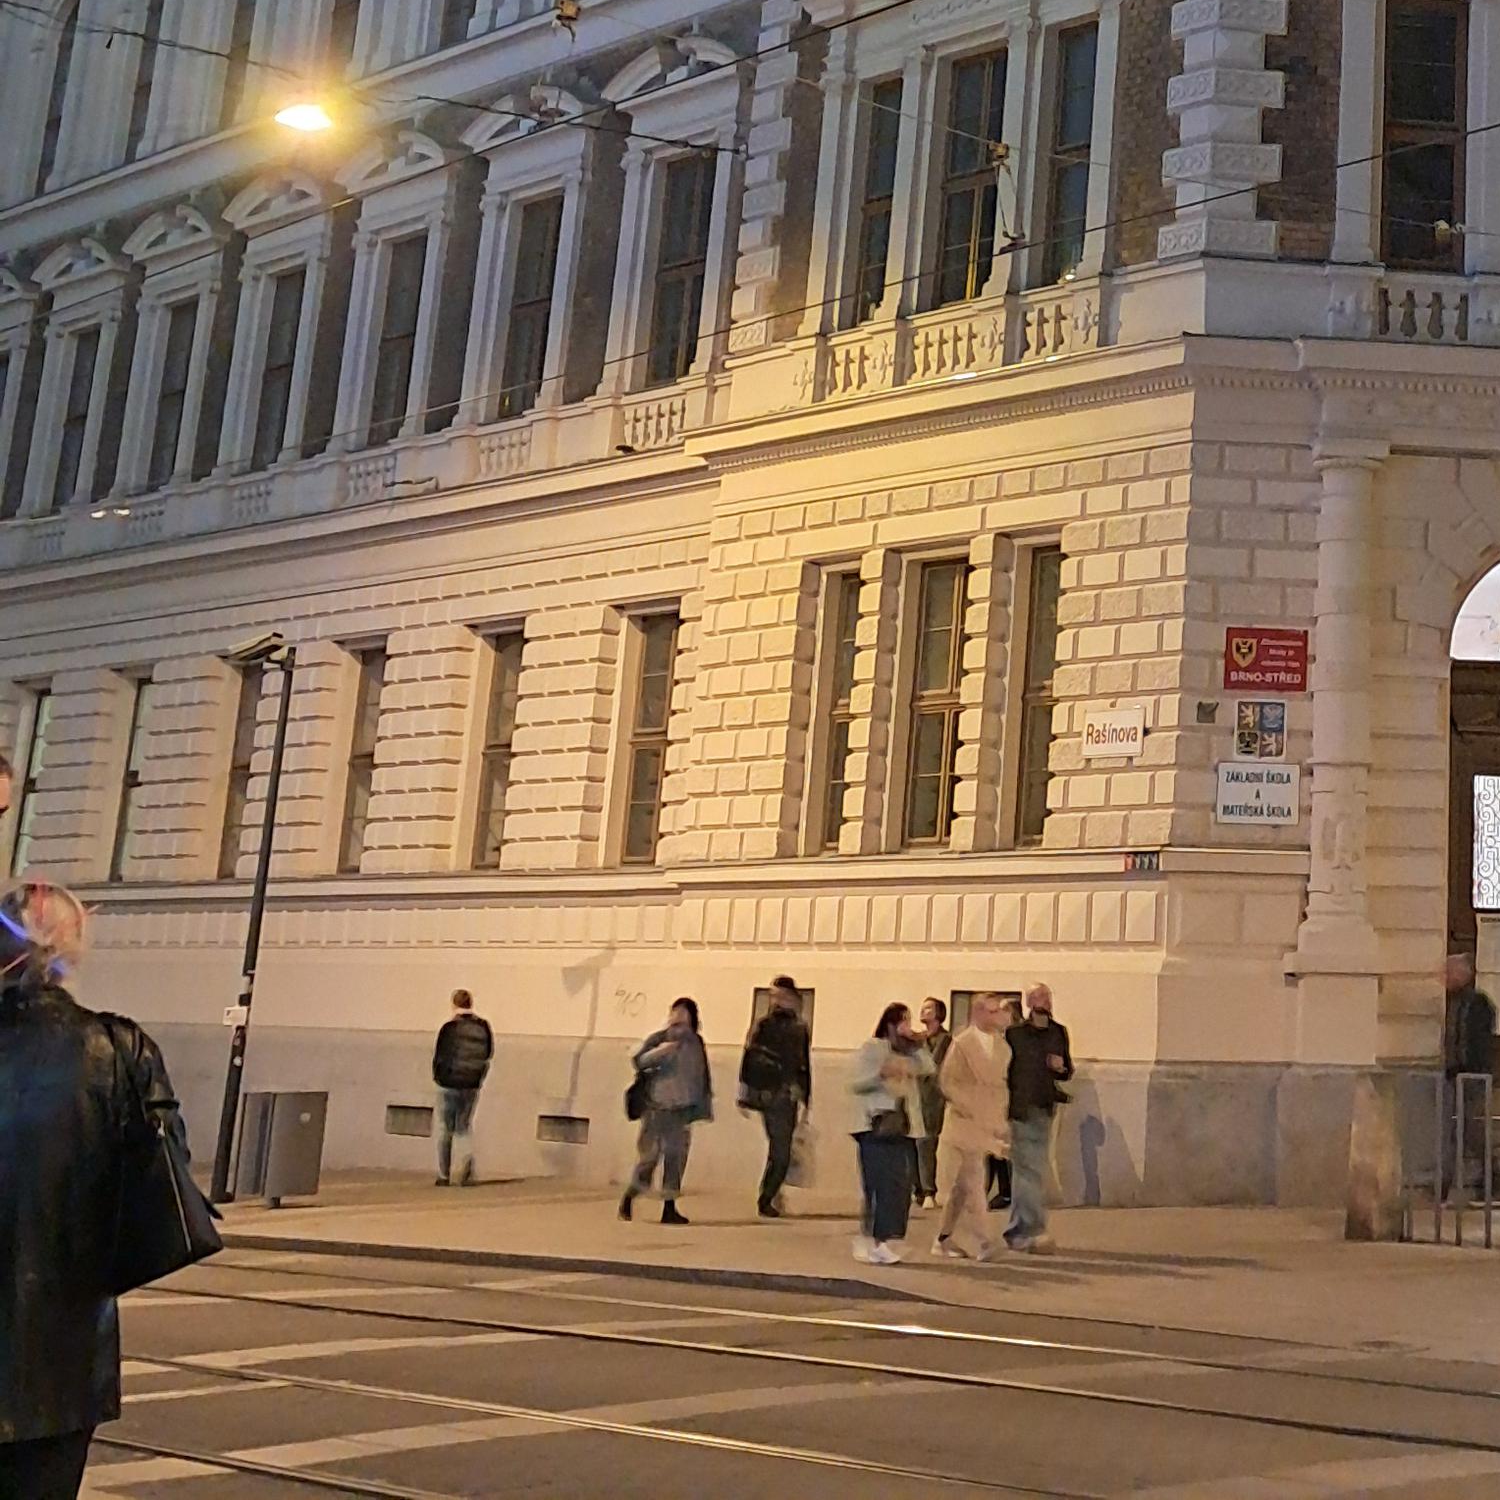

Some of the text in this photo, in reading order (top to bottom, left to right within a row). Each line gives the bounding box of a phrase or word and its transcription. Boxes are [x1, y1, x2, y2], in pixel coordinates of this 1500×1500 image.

[1230, 671, 1302, 684] BRNO-STŘED
[1085, 723, 1138, 745] Rašínova
[1266, 770, 1291, 784] ŠKOLA
[1255, 788, 1260, 800] A
[1223, 803, 1292, 818] MATEŘSKÁ ŠKOLA
